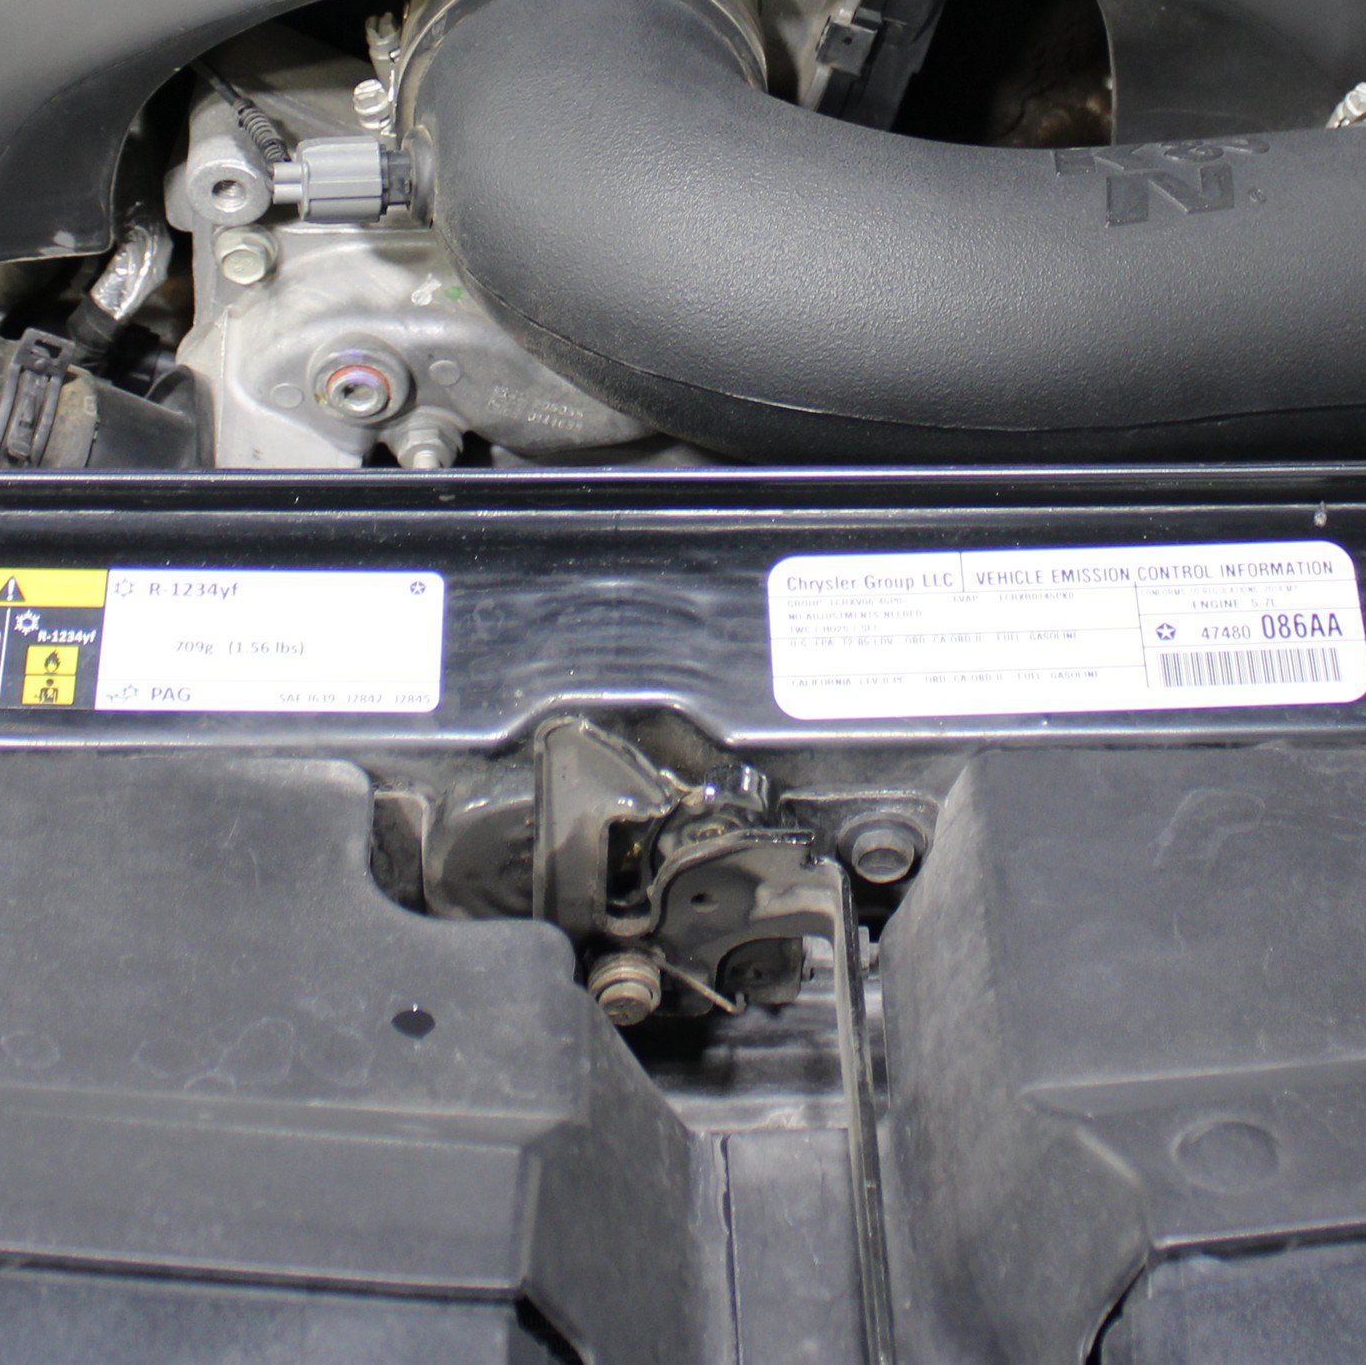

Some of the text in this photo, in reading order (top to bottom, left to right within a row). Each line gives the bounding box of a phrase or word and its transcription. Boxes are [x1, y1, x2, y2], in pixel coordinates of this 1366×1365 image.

[976, 561, 1333, 586] VEHICLE EMISSION CONTROL INFORMATION
[786, 571, 953, 593] Chrysler Group LLC
[148, 582, 239, 600] R-1234yf
[1201, 612, 1343, 640] 47480 086AA
[37, 630, 96, 645] R-1234yf
[176, 641, 213, 655] 709g
[276, 641, 305, 656] lbs)
[151, 687, 191, 702] PAG
[279, 693, 302, 704] SAE
